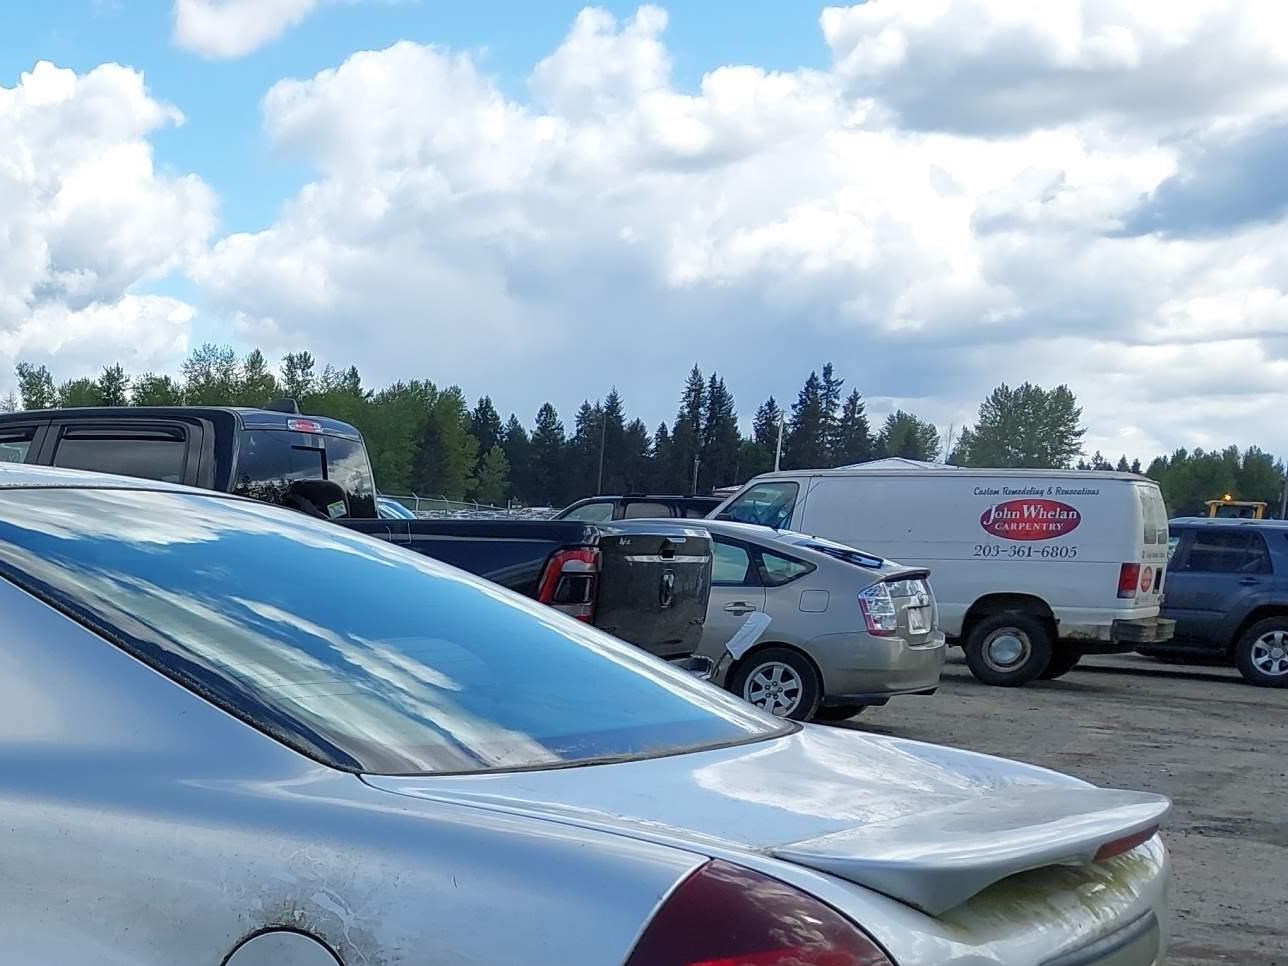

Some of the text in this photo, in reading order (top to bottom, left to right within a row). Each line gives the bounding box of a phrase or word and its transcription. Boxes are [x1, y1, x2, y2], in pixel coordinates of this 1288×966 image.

[973, 486, 1100, 498] Custom Remodeling & Renovations
[983, 504, 1078, 525] John Whelan
[994, 522, 1064, 531] CARPENTRY
[973, 544, 1078, 558] 203-361-6805
